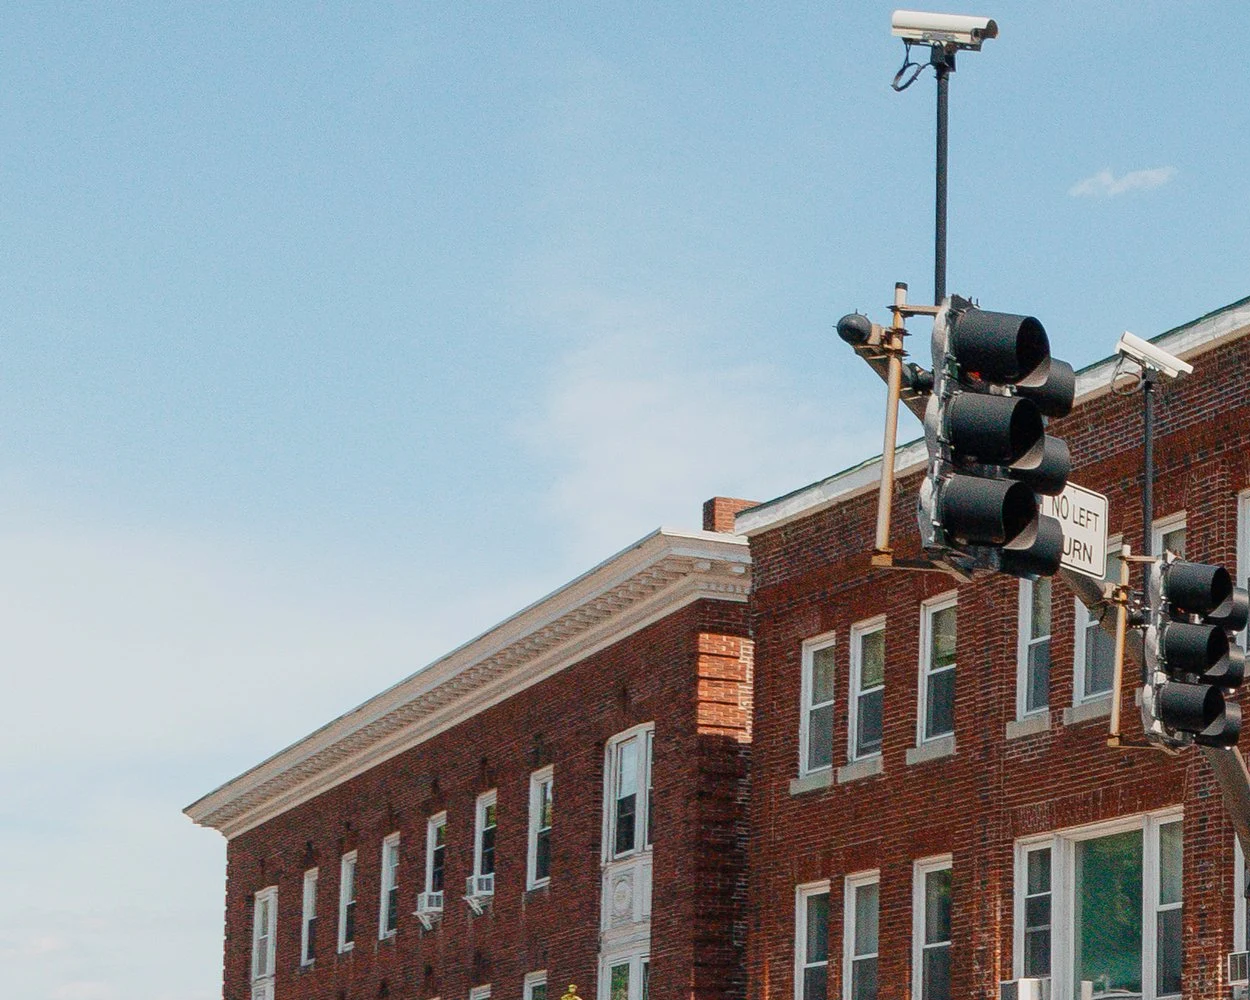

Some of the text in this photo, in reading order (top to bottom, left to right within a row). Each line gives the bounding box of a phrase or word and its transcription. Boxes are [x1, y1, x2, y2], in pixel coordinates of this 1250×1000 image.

[1051, 495, 1100, 532] NO LEFT
[1063, 537, 1093, 564] URN
